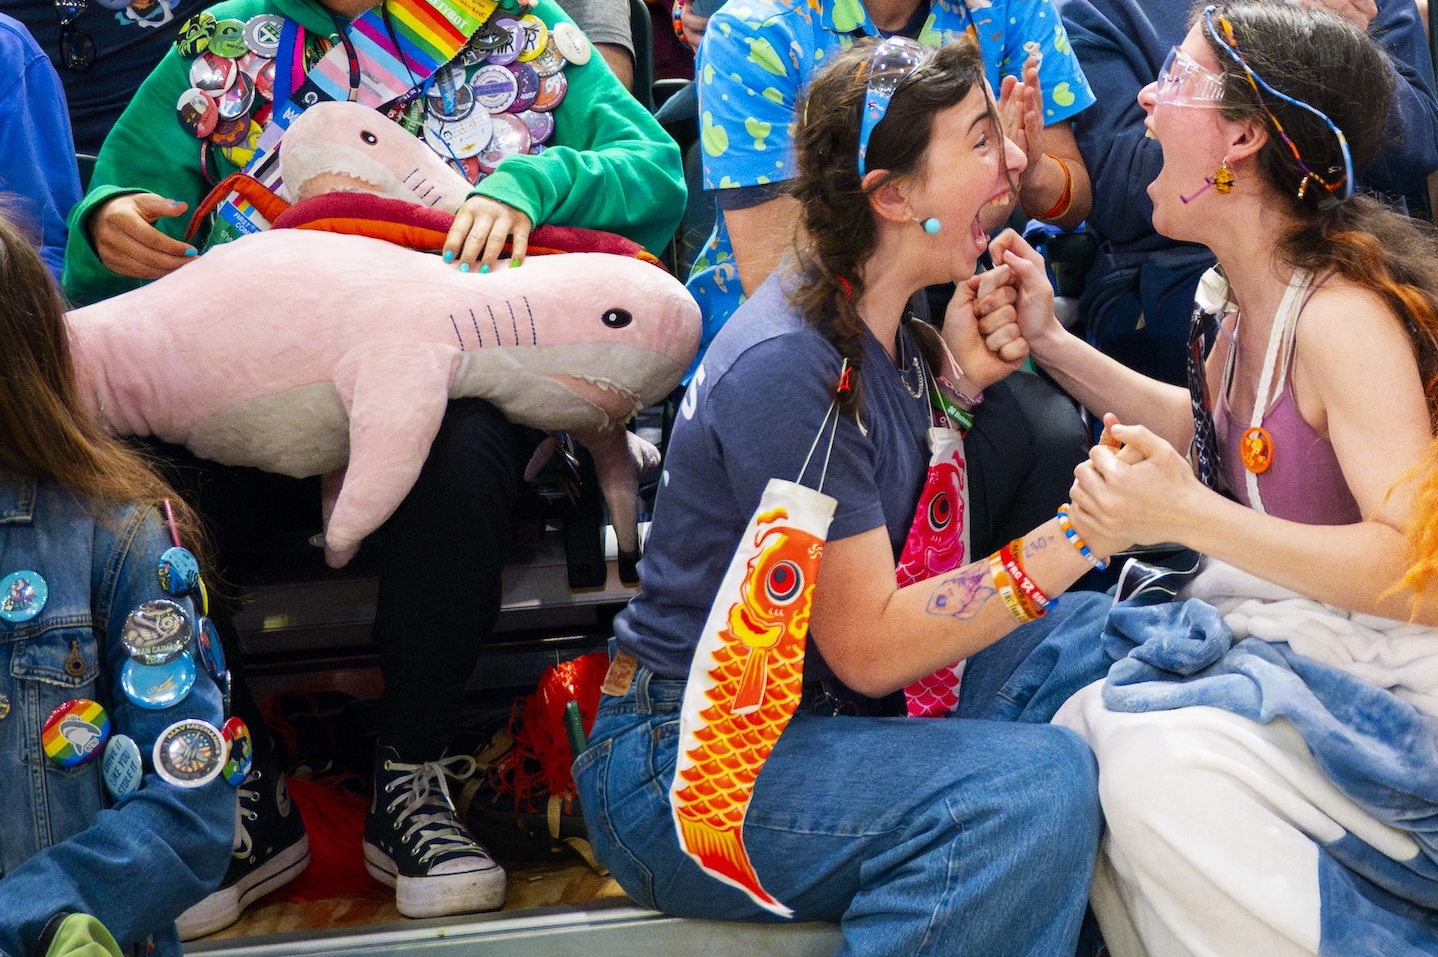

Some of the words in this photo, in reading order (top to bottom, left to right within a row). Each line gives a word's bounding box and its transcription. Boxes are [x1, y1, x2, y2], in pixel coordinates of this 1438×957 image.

[167, 725, 186, 739] MAV
[103, 746, 118, 774] DRIVE
[114, 739, 122, 750] IT
[110, 765, 122, 787] LIKE
[117, 748, 131, 768] YOU
[117, 769, 133, 796] STOLE
[130, 759, 138, 773] IT
